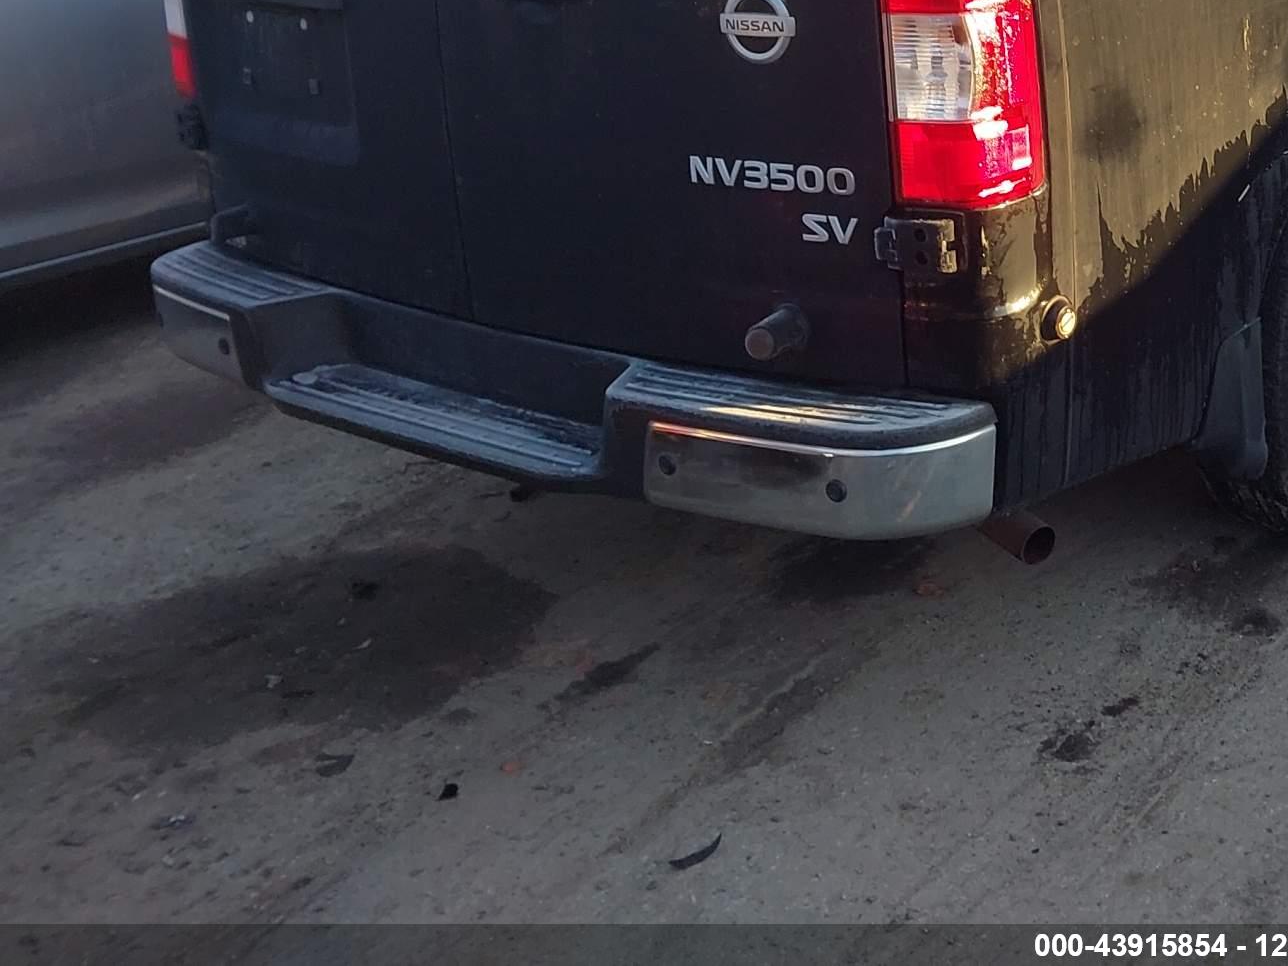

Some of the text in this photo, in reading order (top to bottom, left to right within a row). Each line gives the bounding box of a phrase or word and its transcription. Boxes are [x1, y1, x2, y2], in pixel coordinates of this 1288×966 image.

[725, 18, 785, 33] NISSAN
[689, 155, 856, 196] NV3500
[801, 213, 858, 245] SV
